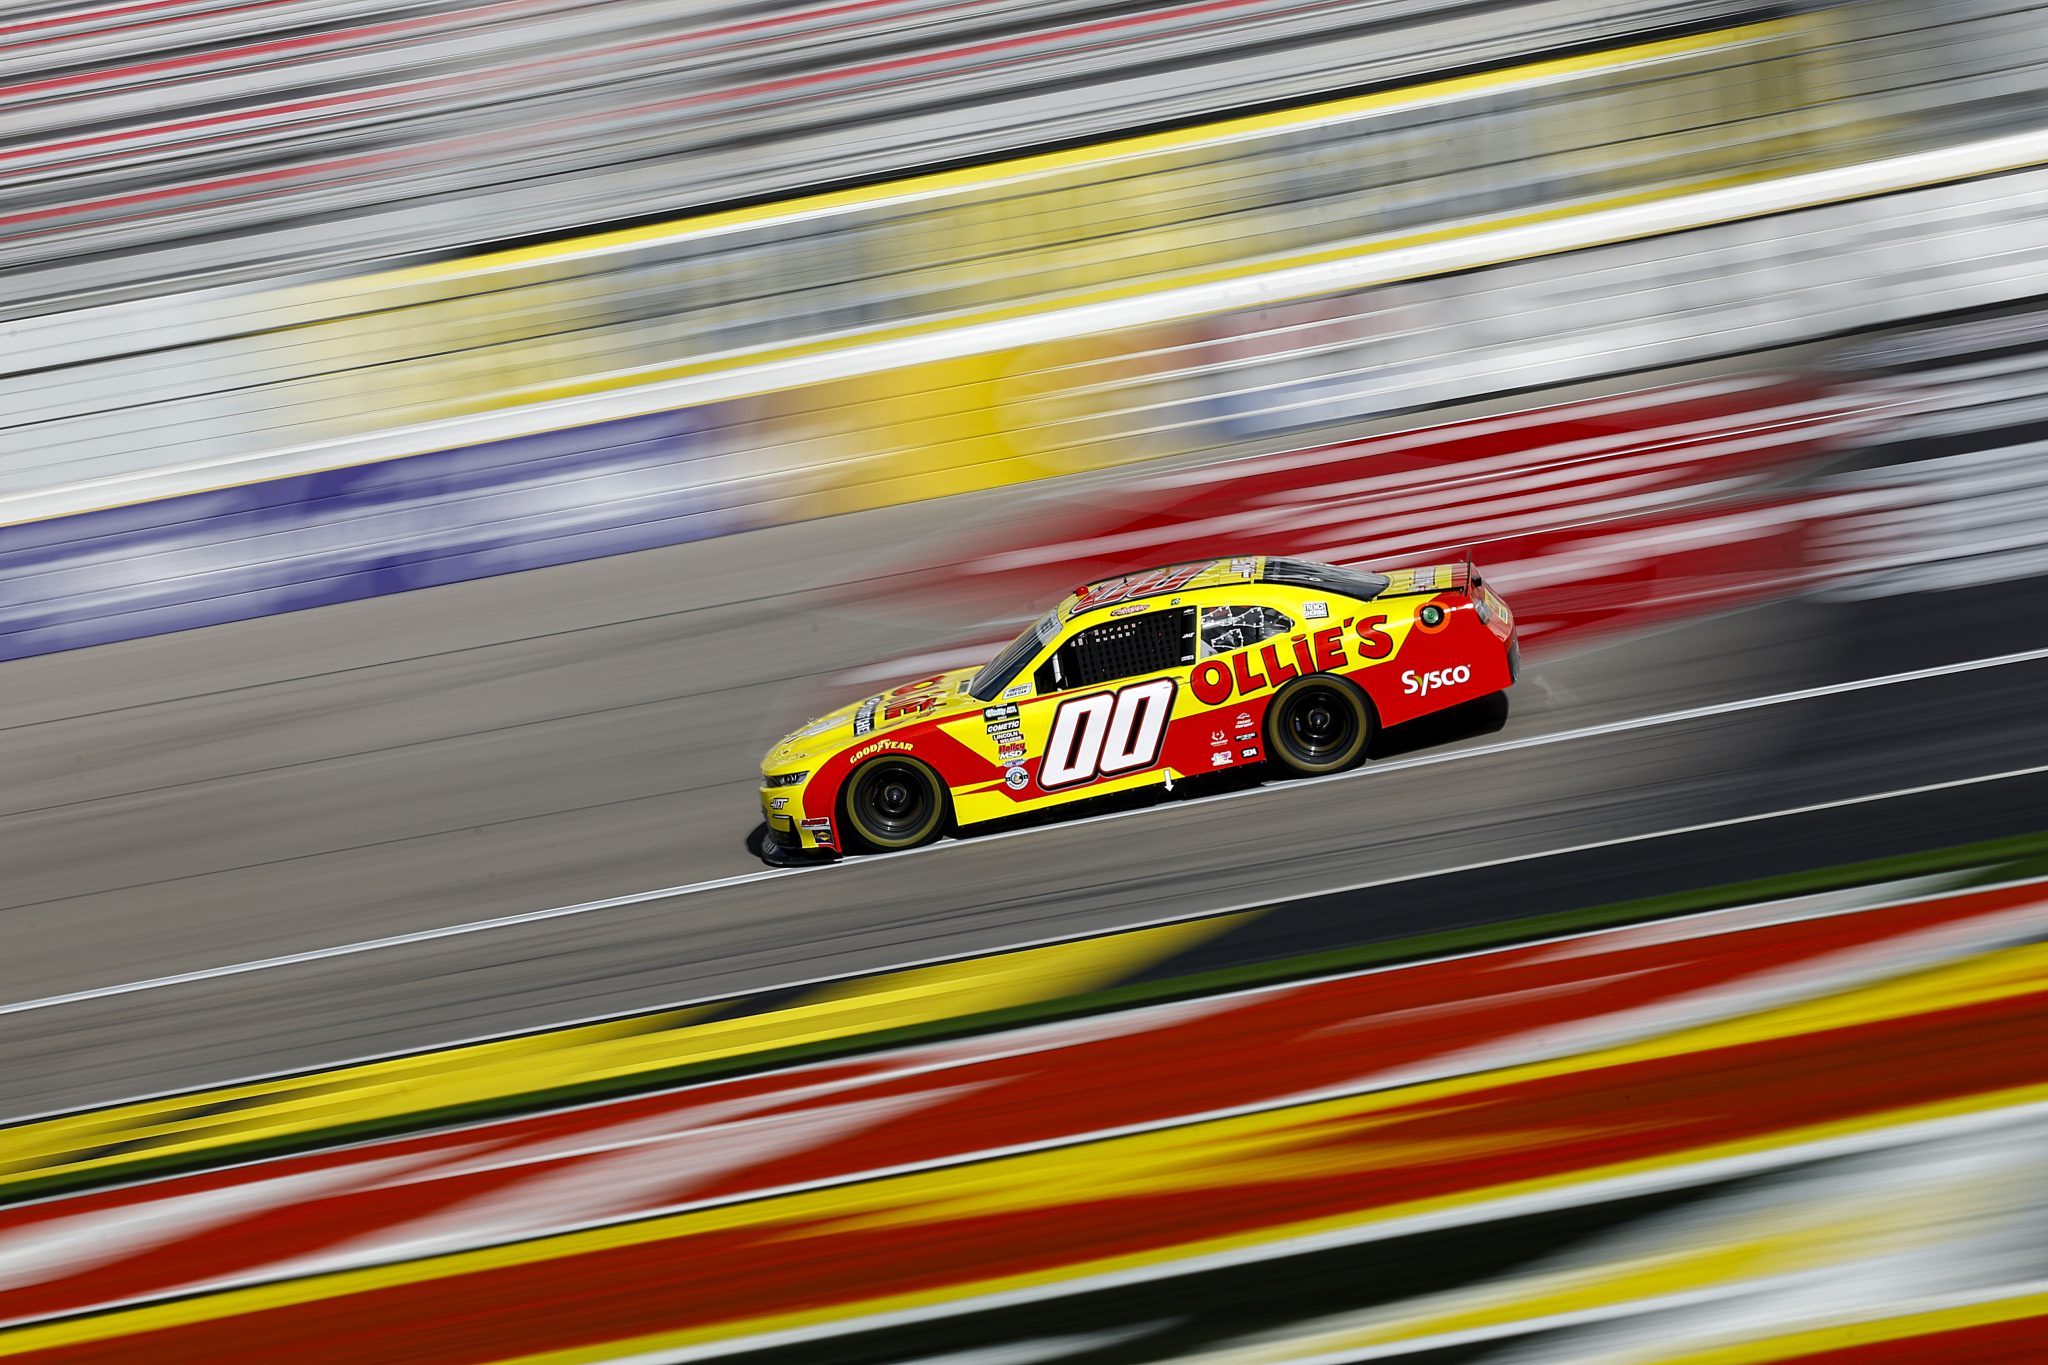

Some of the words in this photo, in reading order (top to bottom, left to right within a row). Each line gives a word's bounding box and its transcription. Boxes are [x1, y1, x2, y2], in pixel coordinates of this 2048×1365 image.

[987, 721, 1020, 733] COMETIC
[993, 731, 1018, 740] LINCOLN
[1038, 677, 1177, 791] 00
[849, 739, 913, 764] GOODYEAR
[999, 750, 1023, 760] MSD
